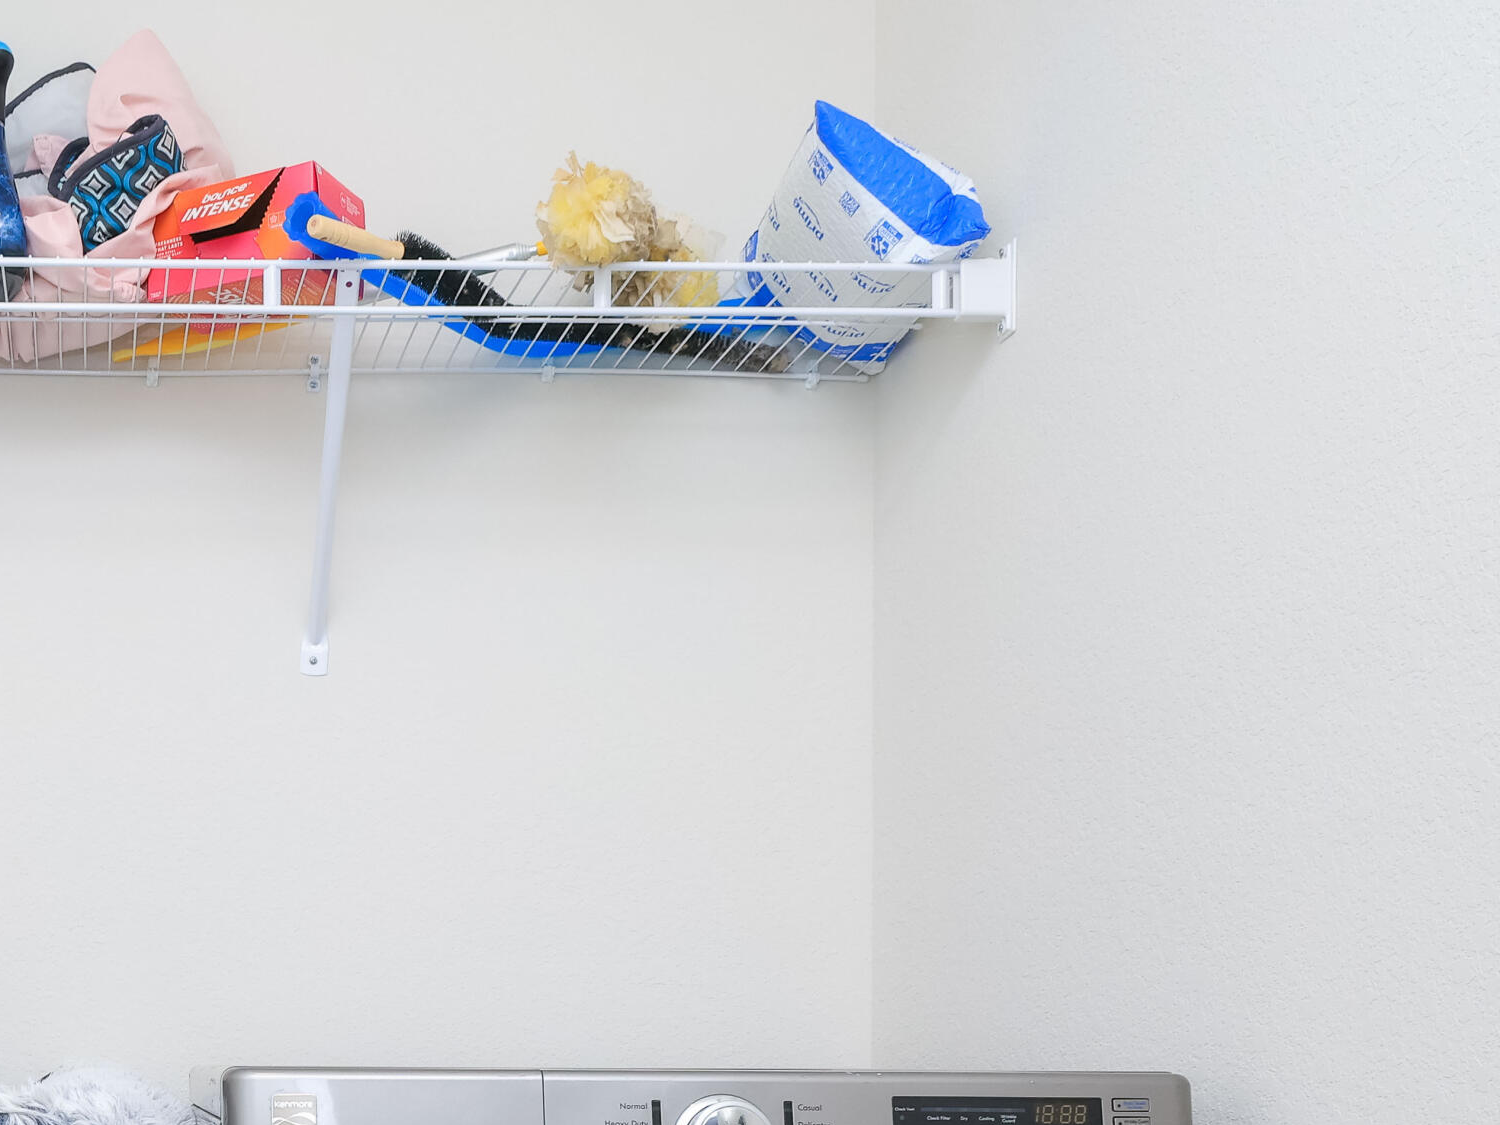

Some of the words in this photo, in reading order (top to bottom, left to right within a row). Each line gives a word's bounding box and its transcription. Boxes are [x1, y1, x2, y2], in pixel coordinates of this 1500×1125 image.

[202, 182, 250, 205] bounce
[181, 193, 255, 223] INTENSE
[619, 1102, 648, 1110] Normal
